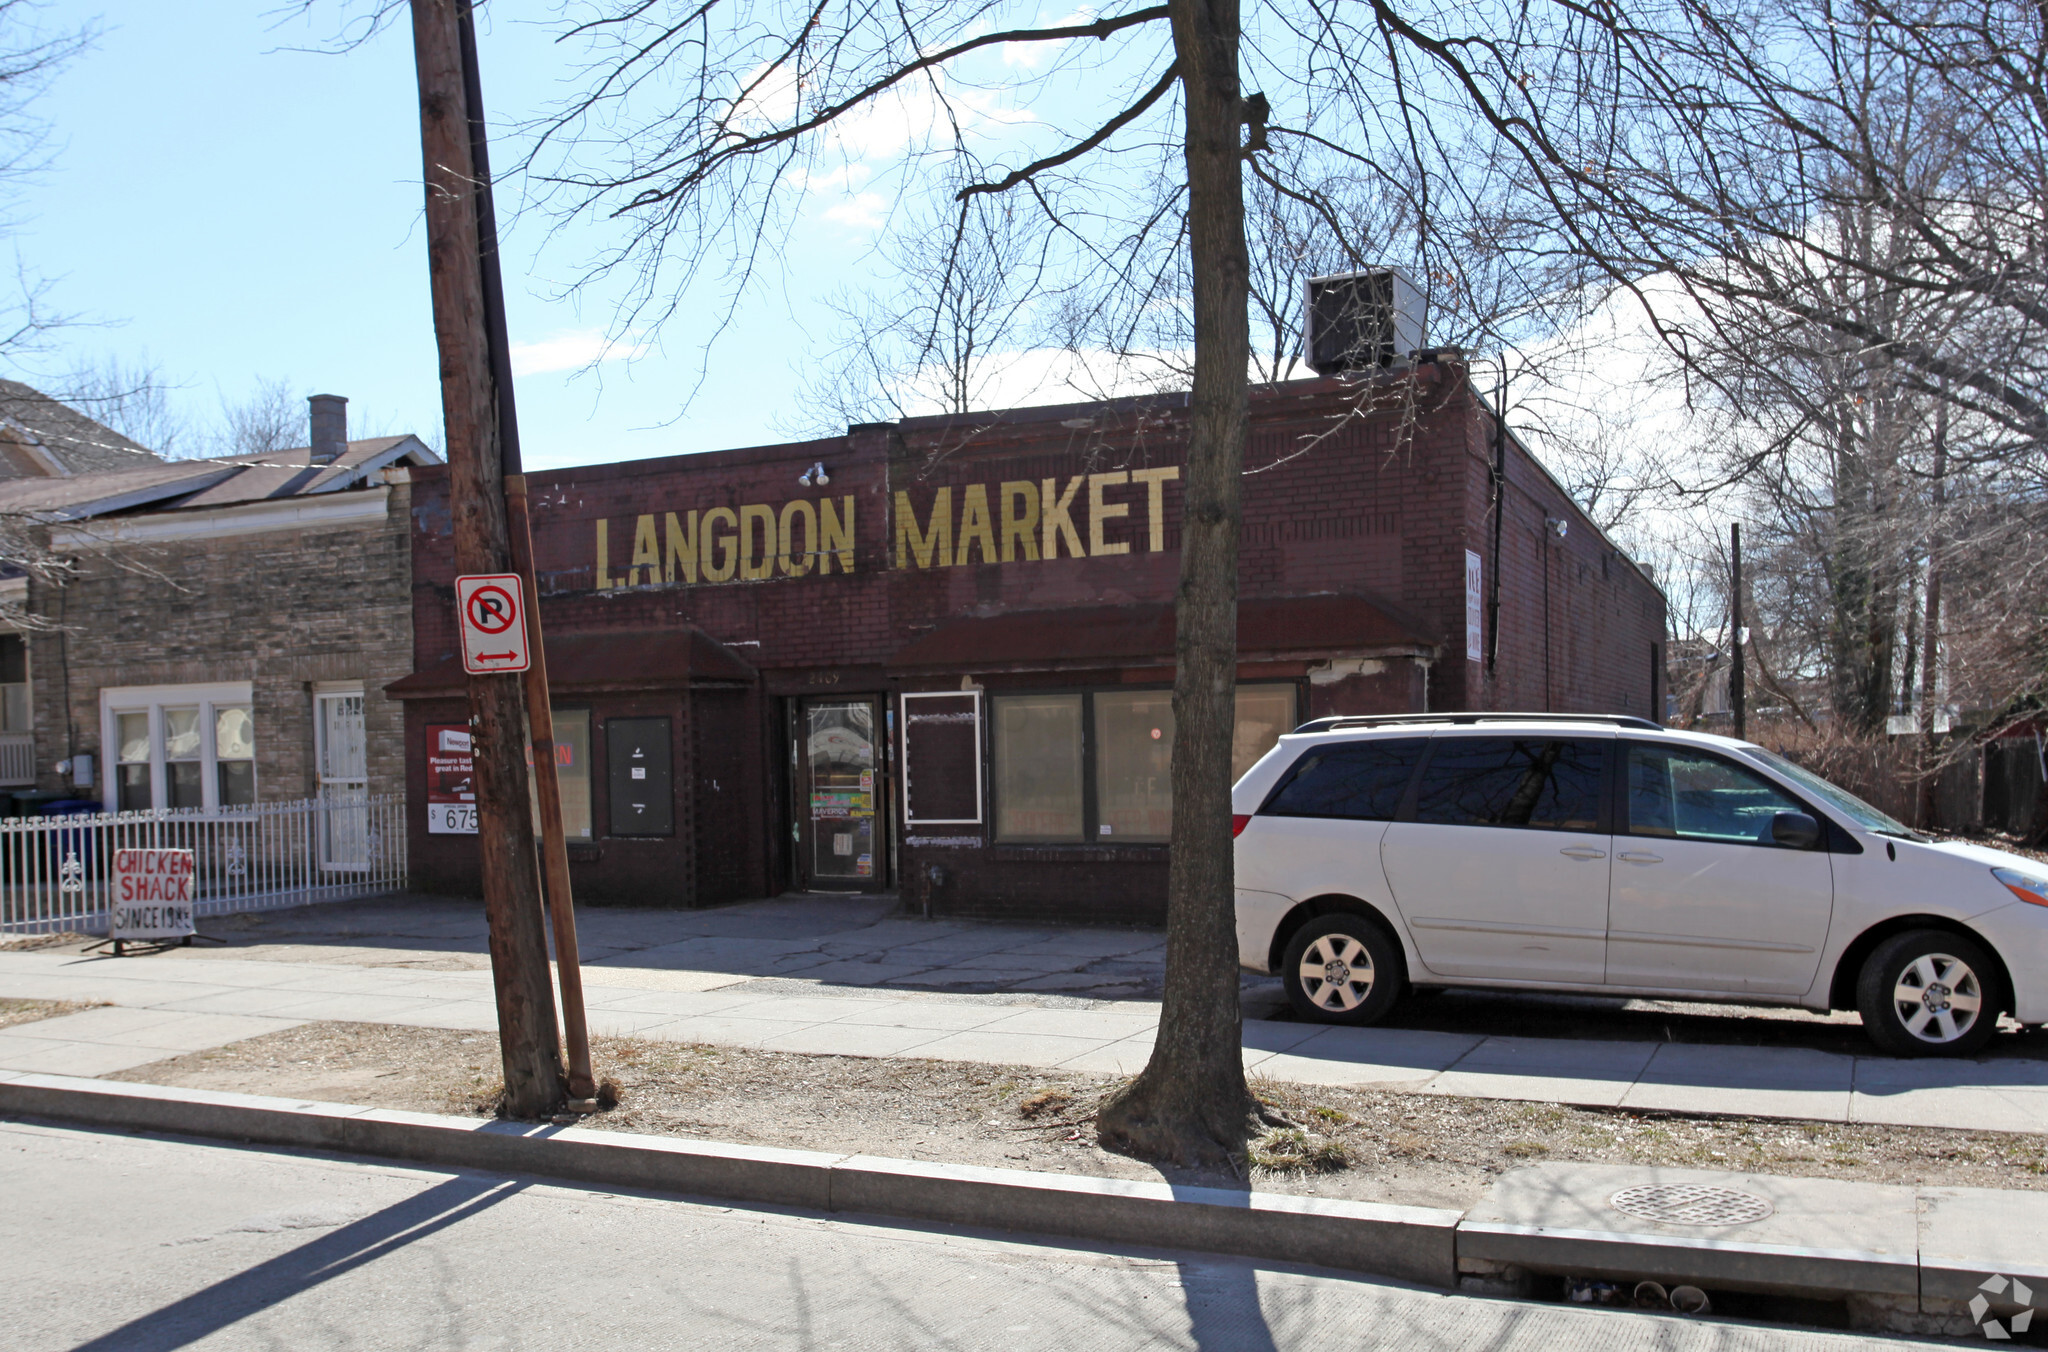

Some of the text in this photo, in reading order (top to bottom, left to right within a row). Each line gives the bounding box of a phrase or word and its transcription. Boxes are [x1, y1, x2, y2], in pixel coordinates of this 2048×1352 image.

[596, 466, 1180, 590] LANGDON MARKET
[479, 598, 503, 624] P
[117, 850, 192, 875] CHICKEN
[121, 876, 189, 902] SHACK
[115, 906, 159, 930] SINCE
